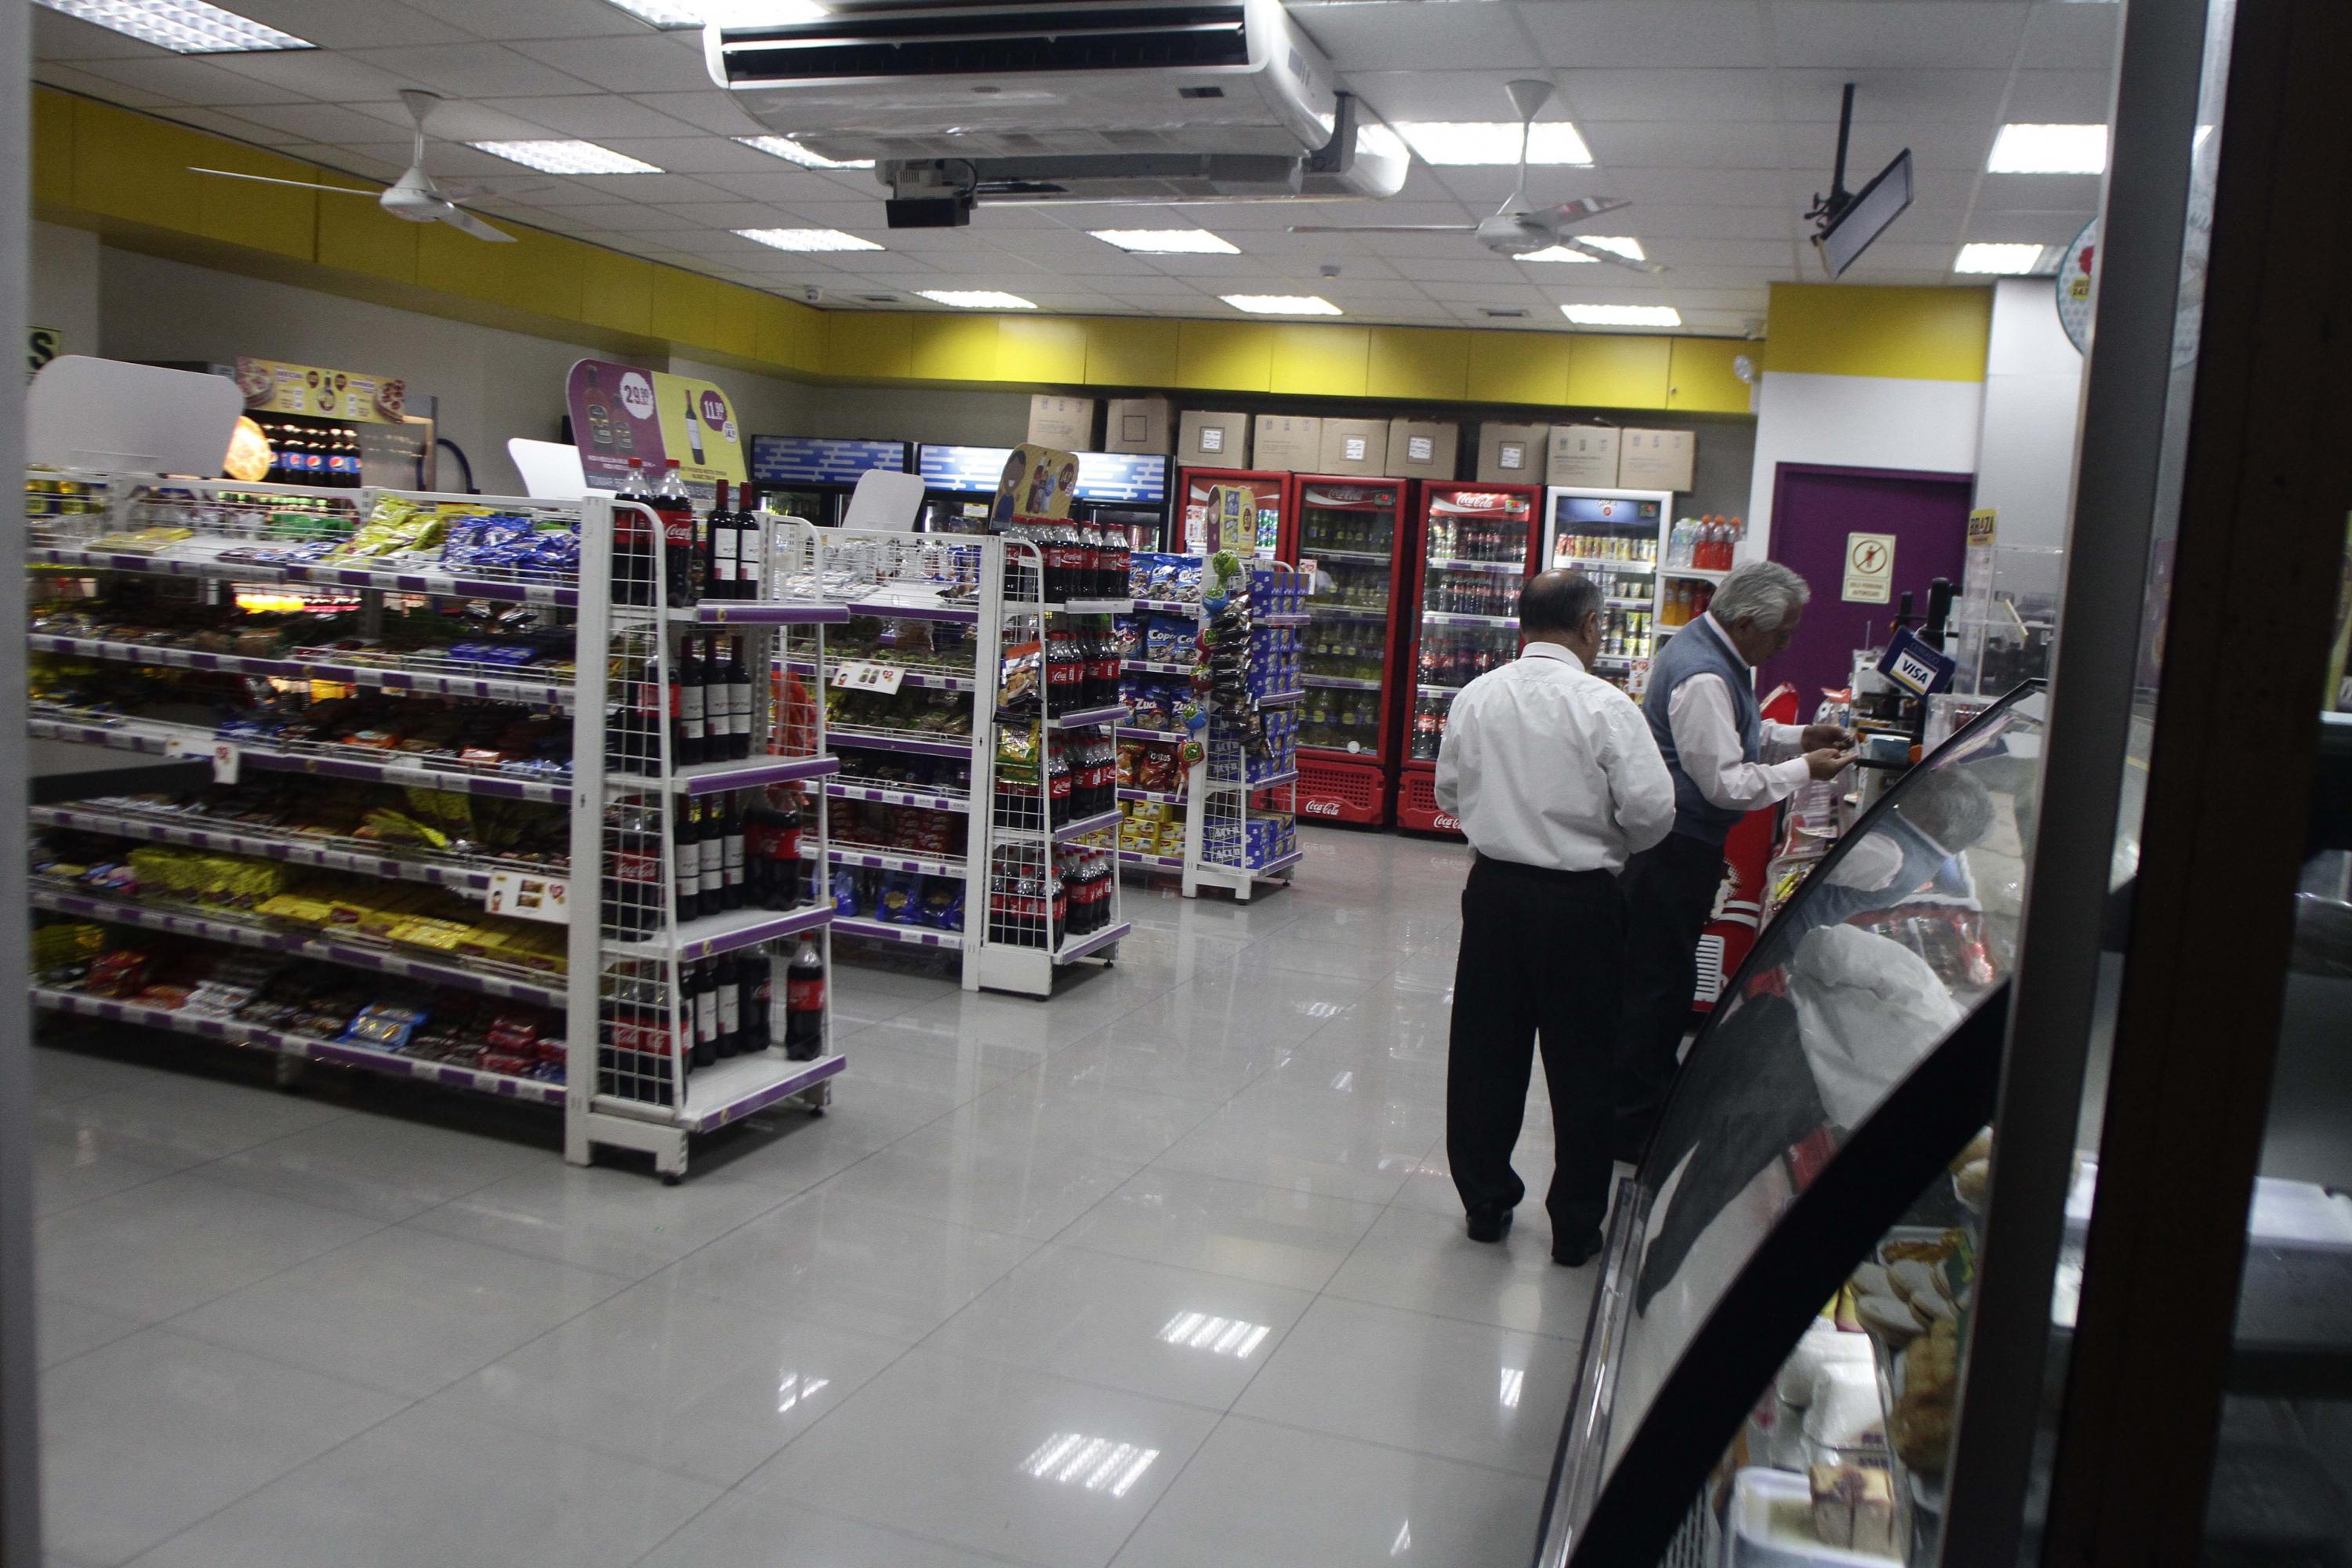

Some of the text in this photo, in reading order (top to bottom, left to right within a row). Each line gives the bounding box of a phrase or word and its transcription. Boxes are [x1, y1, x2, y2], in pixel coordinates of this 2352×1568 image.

[1456, 494, 1494, 508] Coca-Cola
[1902, 659, 1929, 684] VISA
[1305, 800, 1341, 815] Coca-Cola
